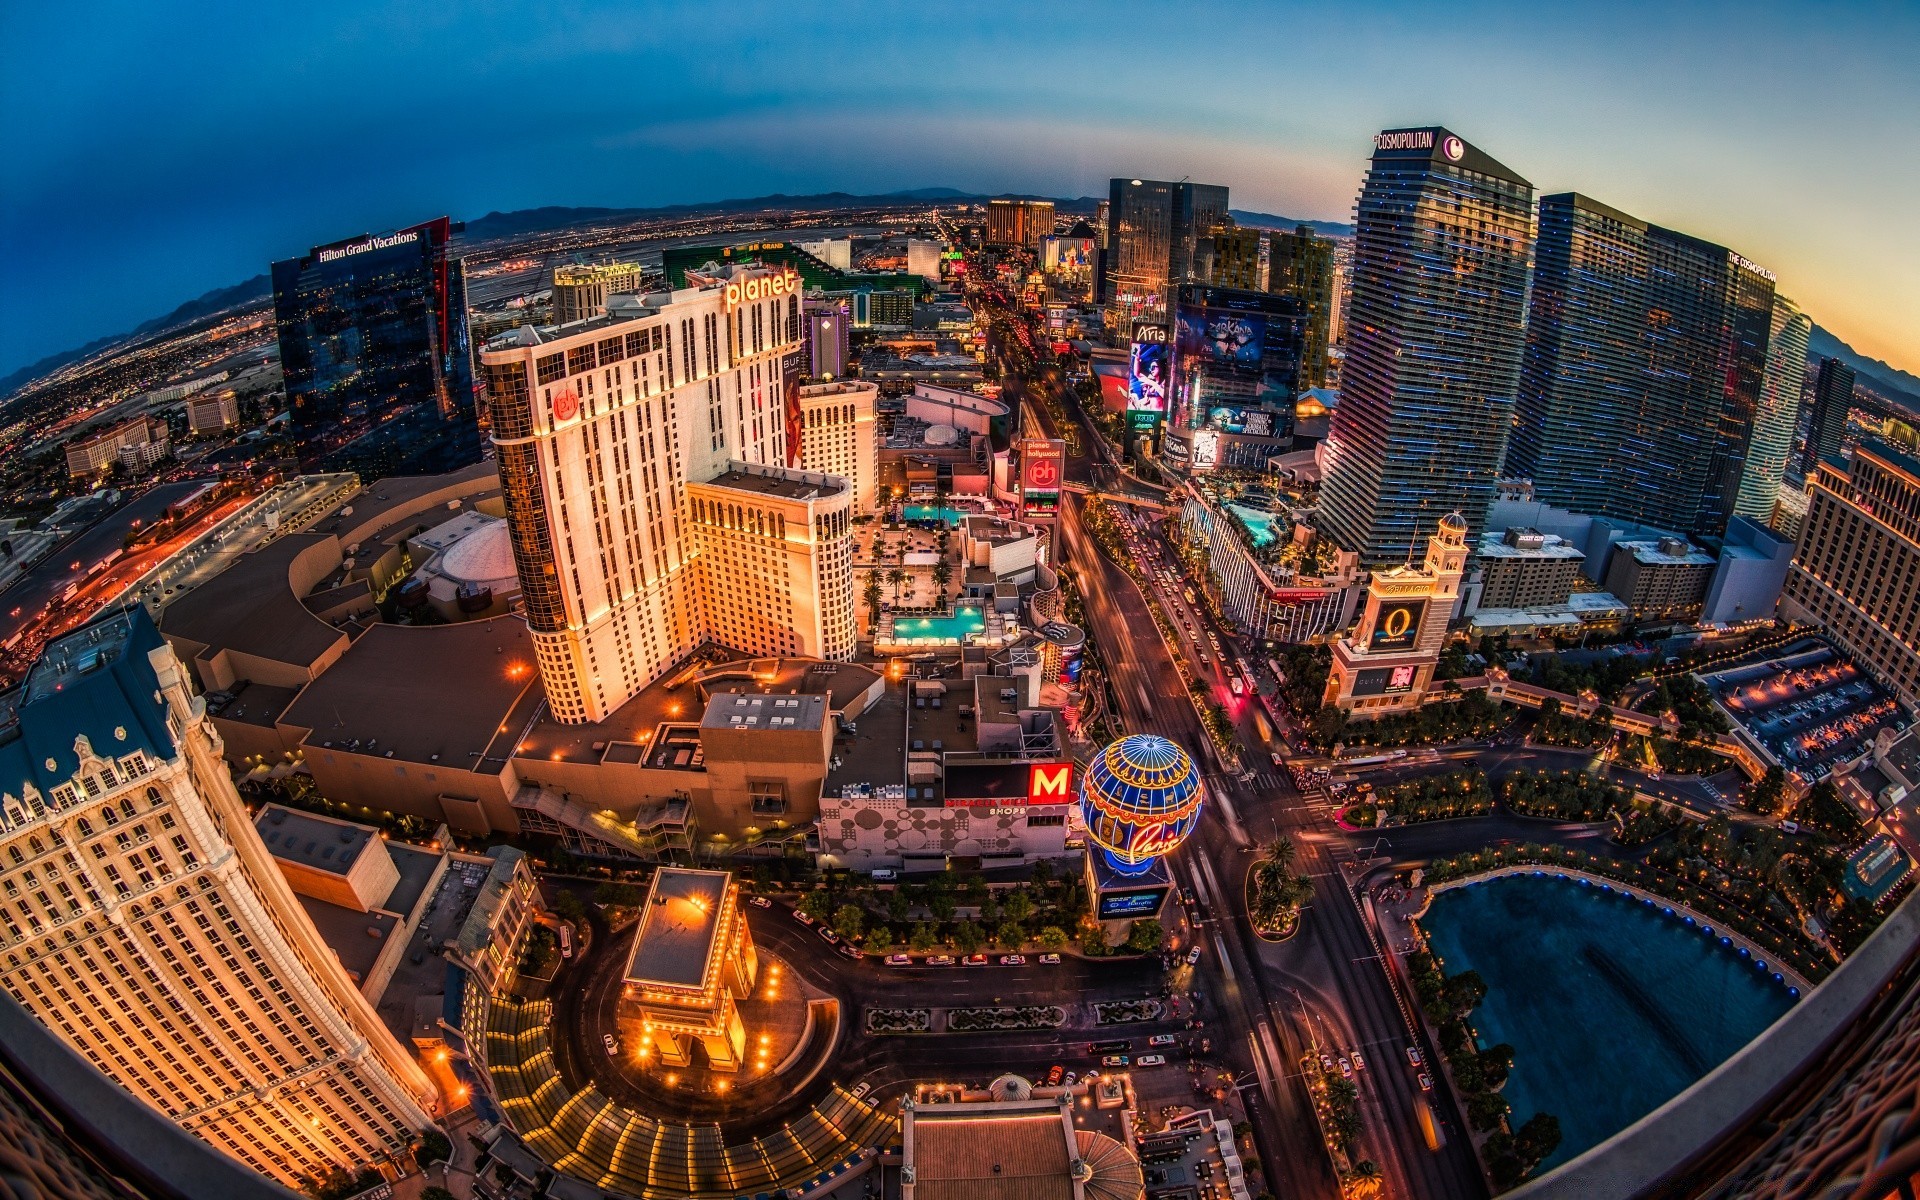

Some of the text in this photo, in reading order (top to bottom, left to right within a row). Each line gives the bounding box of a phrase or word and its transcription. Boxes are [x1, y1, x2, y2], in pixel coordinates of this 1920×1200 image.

[1378, 131, 1433, 150] COSMOPOLITAN
[319, 231, 418, 263] Hilton Grand Vacations
[940, 251, 963, 260] MGM
[1728, 251, 1777, 283] THE COSMOPOLITAN
[726, 269, 796, 313] planet
[1136, 325, 1166, 342] Aria
[1028, 442, 1050, 450] planet
[1028, 449, 1060, 458] hollywood
[1033, 460, 1056, 482] ph
[1386, 584, 1430, 594] BELLAGIO
[1032, 767, 1069, 796] M
[945, 798, 1026, 807] MIRACLE MILE
[1130, 823, 1179, 865] Paris
